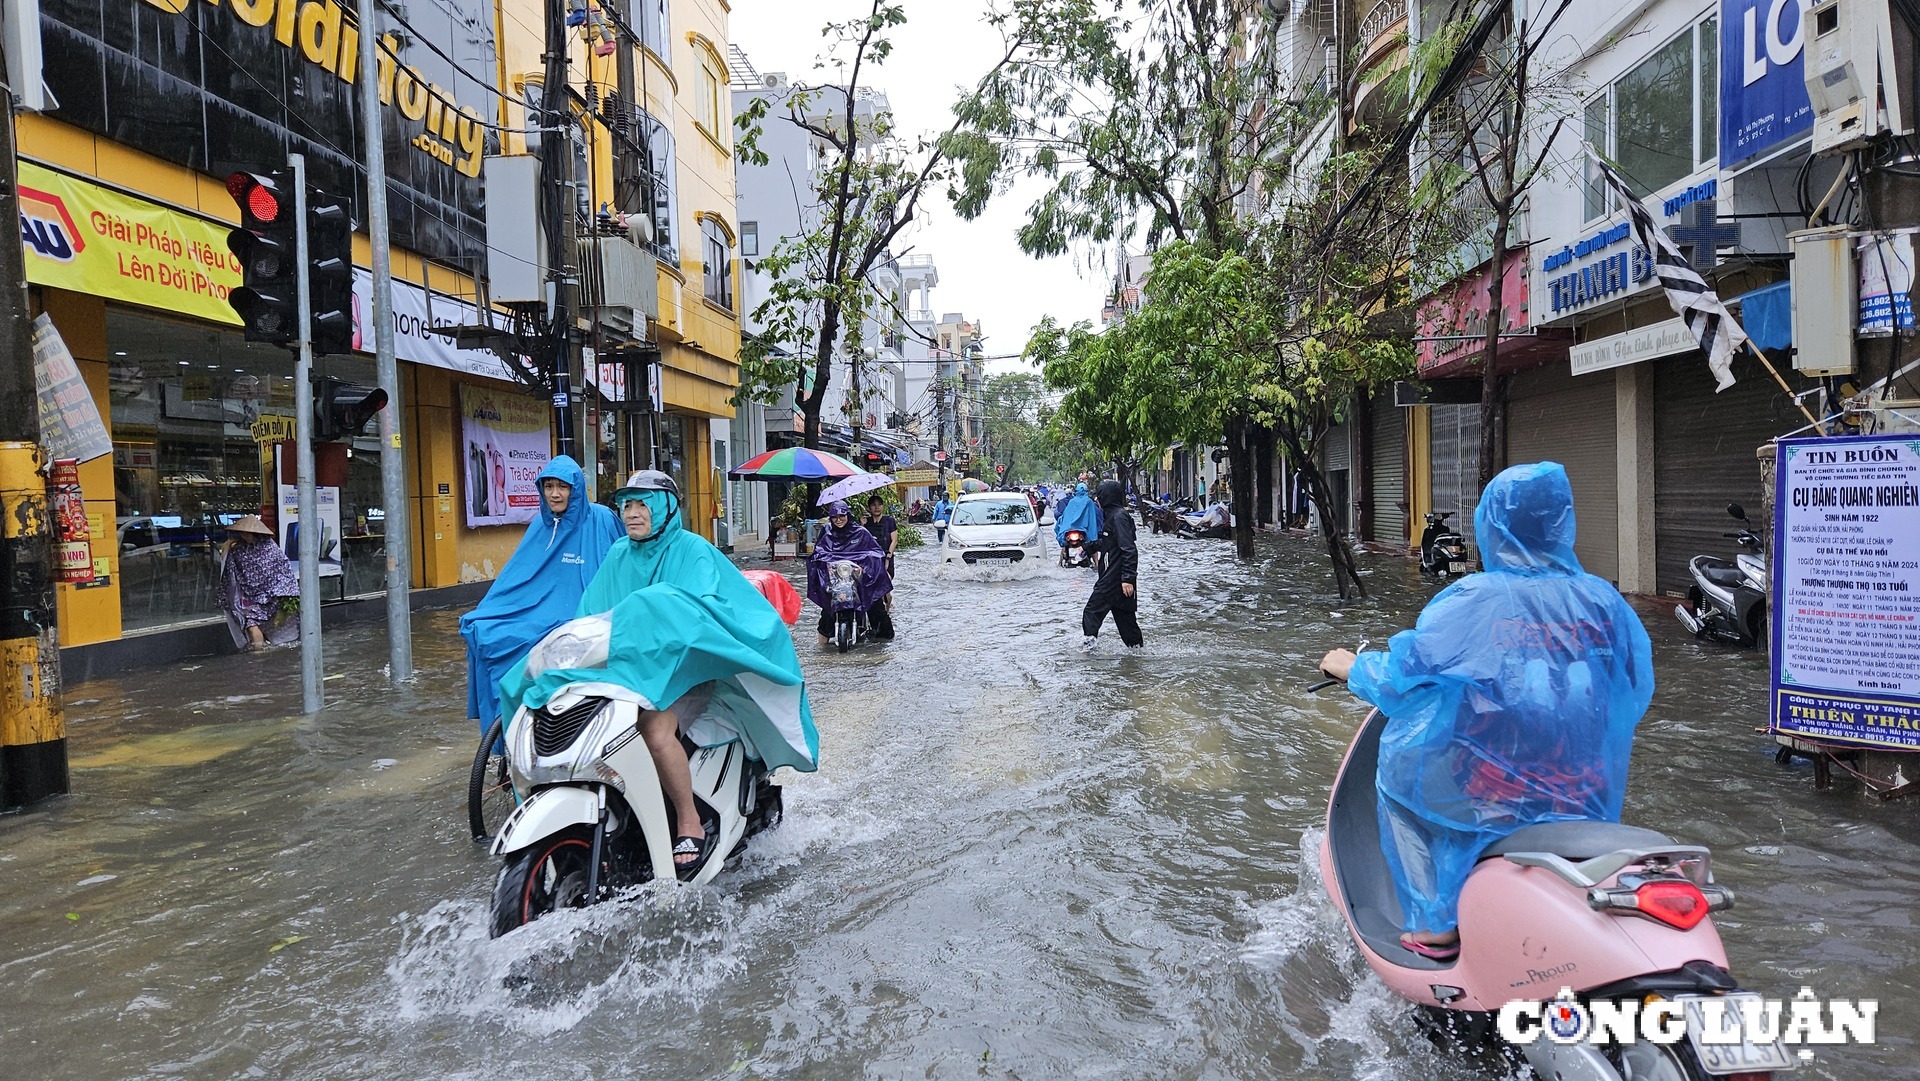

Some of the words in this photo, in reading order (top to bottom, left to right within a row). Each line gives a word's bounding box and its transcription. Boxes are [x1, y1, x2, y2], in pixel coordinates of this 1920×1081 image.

[412, 134, 453, 166] .com
[91, 211, 131, 243] Giải
[137, 223, 182, 260] Pháp
[187, 239, 225, 272] Hiệu
[118, 252, 155, 283] Lên
[159, 263, 188, 291] Đời
[1547, 251, 1628, 312] THANH
[1573, 352, 1593, 369] THANH
[1595, 345, 1611, 363] BÌNH
[1656, 329, 1679, 352] phục
[252, 417, 271, 440] ĐIỂM
[1806, 451, 1837, 464] TIN
[1844, 445, 1899, 462] BUỒN
[510, 466, 521, 481] Trả
[522, 467, 537, 483] Góp
[1793, 487, 1809, 511] CỤ
[1812, 482, 1837, 511] ĐẶNG
[1840, 486, 1873, 509] QUANG
[1876, 481, 1919, 507] NGHIÊN
[1824, 514, 1840, 522] SINH
[1841, 513, 1859, 522] NĂM
[1862, 514, 1879, 522] 1922
[1816, 547, 1825, 555] CỤ
[1835, 548, 1843, 556] TẠ
[1845, 547, 1858, 555] THẾ
[1860, 548, 1873, 556] VÀO
[1875, 547, 1888, 556] HỒI
[1823, 557, 1840, 566] NGÀY
[1851, 558, 1874, 568] THÁNG
[1876, 560, 1880, 568] 9
[1882, 559, 1899, 569] NĂM
[1901, 561, 1919, 569] 2024
[1801, 578, 1826, 589] THƯỢNG
[1827, 579, 1854, 590] THƯỢNG
[1856, 581, 1870, 592] THỌ
[1872, 582, 1887, 591] 103
[1889, 579, 1908, 591] TUỔI
[1852, 593, 1865, 601] NGÀY
[1879, 622, 1898, 630] THÁNG
[1879, 631, 1898, 640] THÁNG
[1885, 640, 1894, 648] HẢI
[1898, 641, 1907, 649] HẢI
[1891, 671, 1902, 679] CÁC
[1858, 680, 1878, 688] Kính
[1881, 681, 1901, 689] báo!
[1789, 695, 1815, 705] CÔNG
[1817, 699, 1829, 707] TY
[1832, 701, 1861, 710] PHỤC
[1864, 704, 1879, 713] VỤ
[1882, 705, 1911, 715] TANG
[1789, 705, 1855, 723] THIÊN
[1803, 718, 1816, 726] TÔN
[1809, 726, 1827, 734] 0913
[1844, 730, 1858, 738] 473
[1865, 732, 1884, 741] 0915
[1902, 736, 1917, 745] 175
